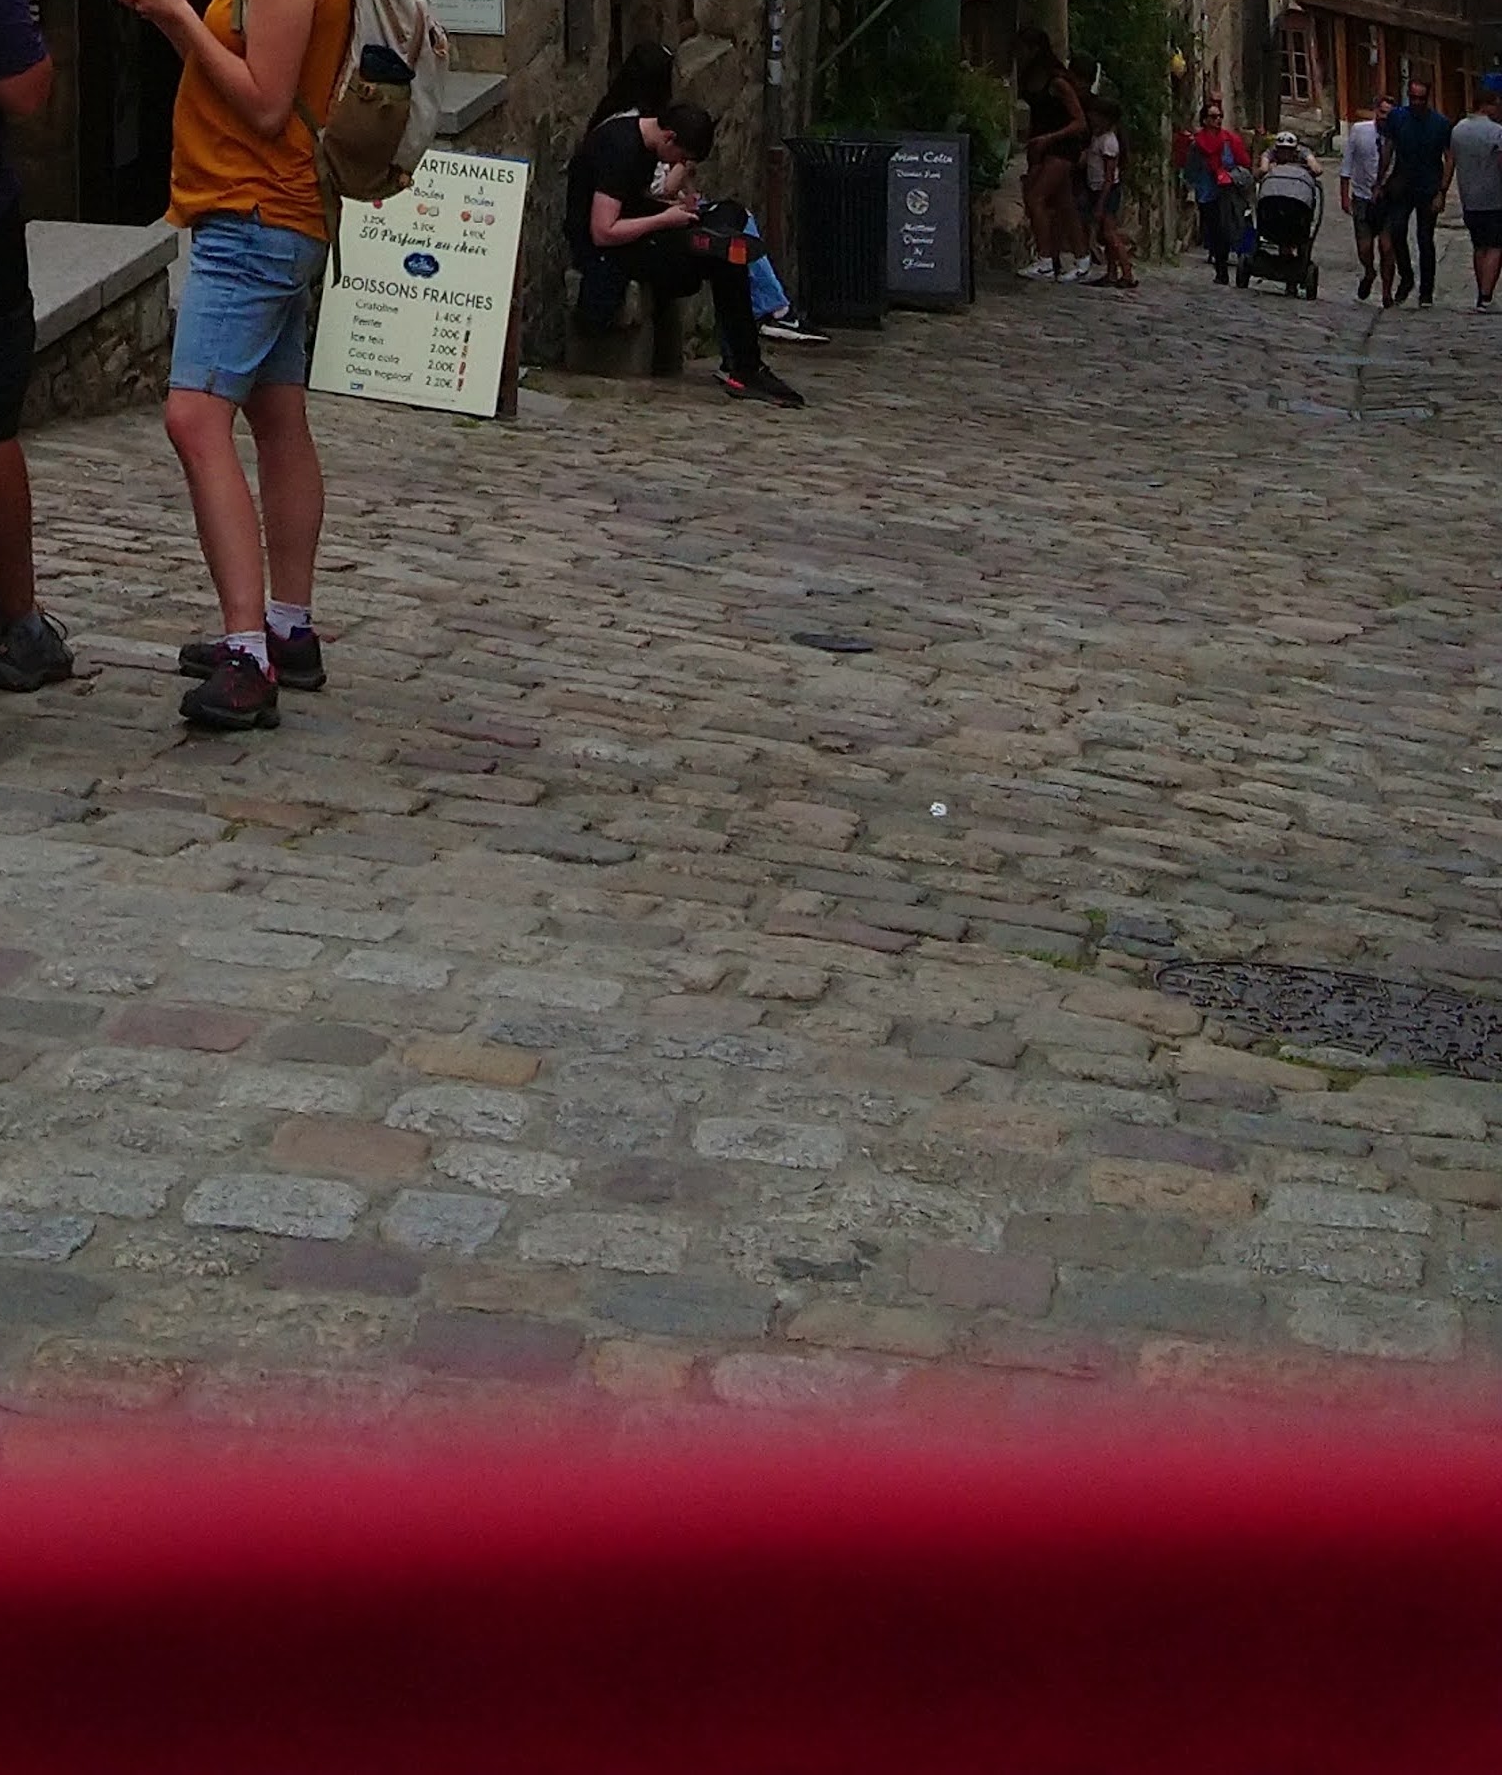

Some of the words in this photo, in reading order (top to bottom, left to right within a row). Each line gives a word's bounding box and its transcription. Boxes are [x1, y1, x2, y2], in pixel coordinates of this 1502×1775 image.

[419, 158, 515, 184] ARTISANALES
[359, 226, 379, 240] 50
[341, 275, 418, 299] BOISSONS
[423, 287, 493, 311] FRAICHES
[350, 331, 366, 343] Ice
[429, 343, 458, 356] 2.00€
[427, 359, 455, 373] 2.00€
